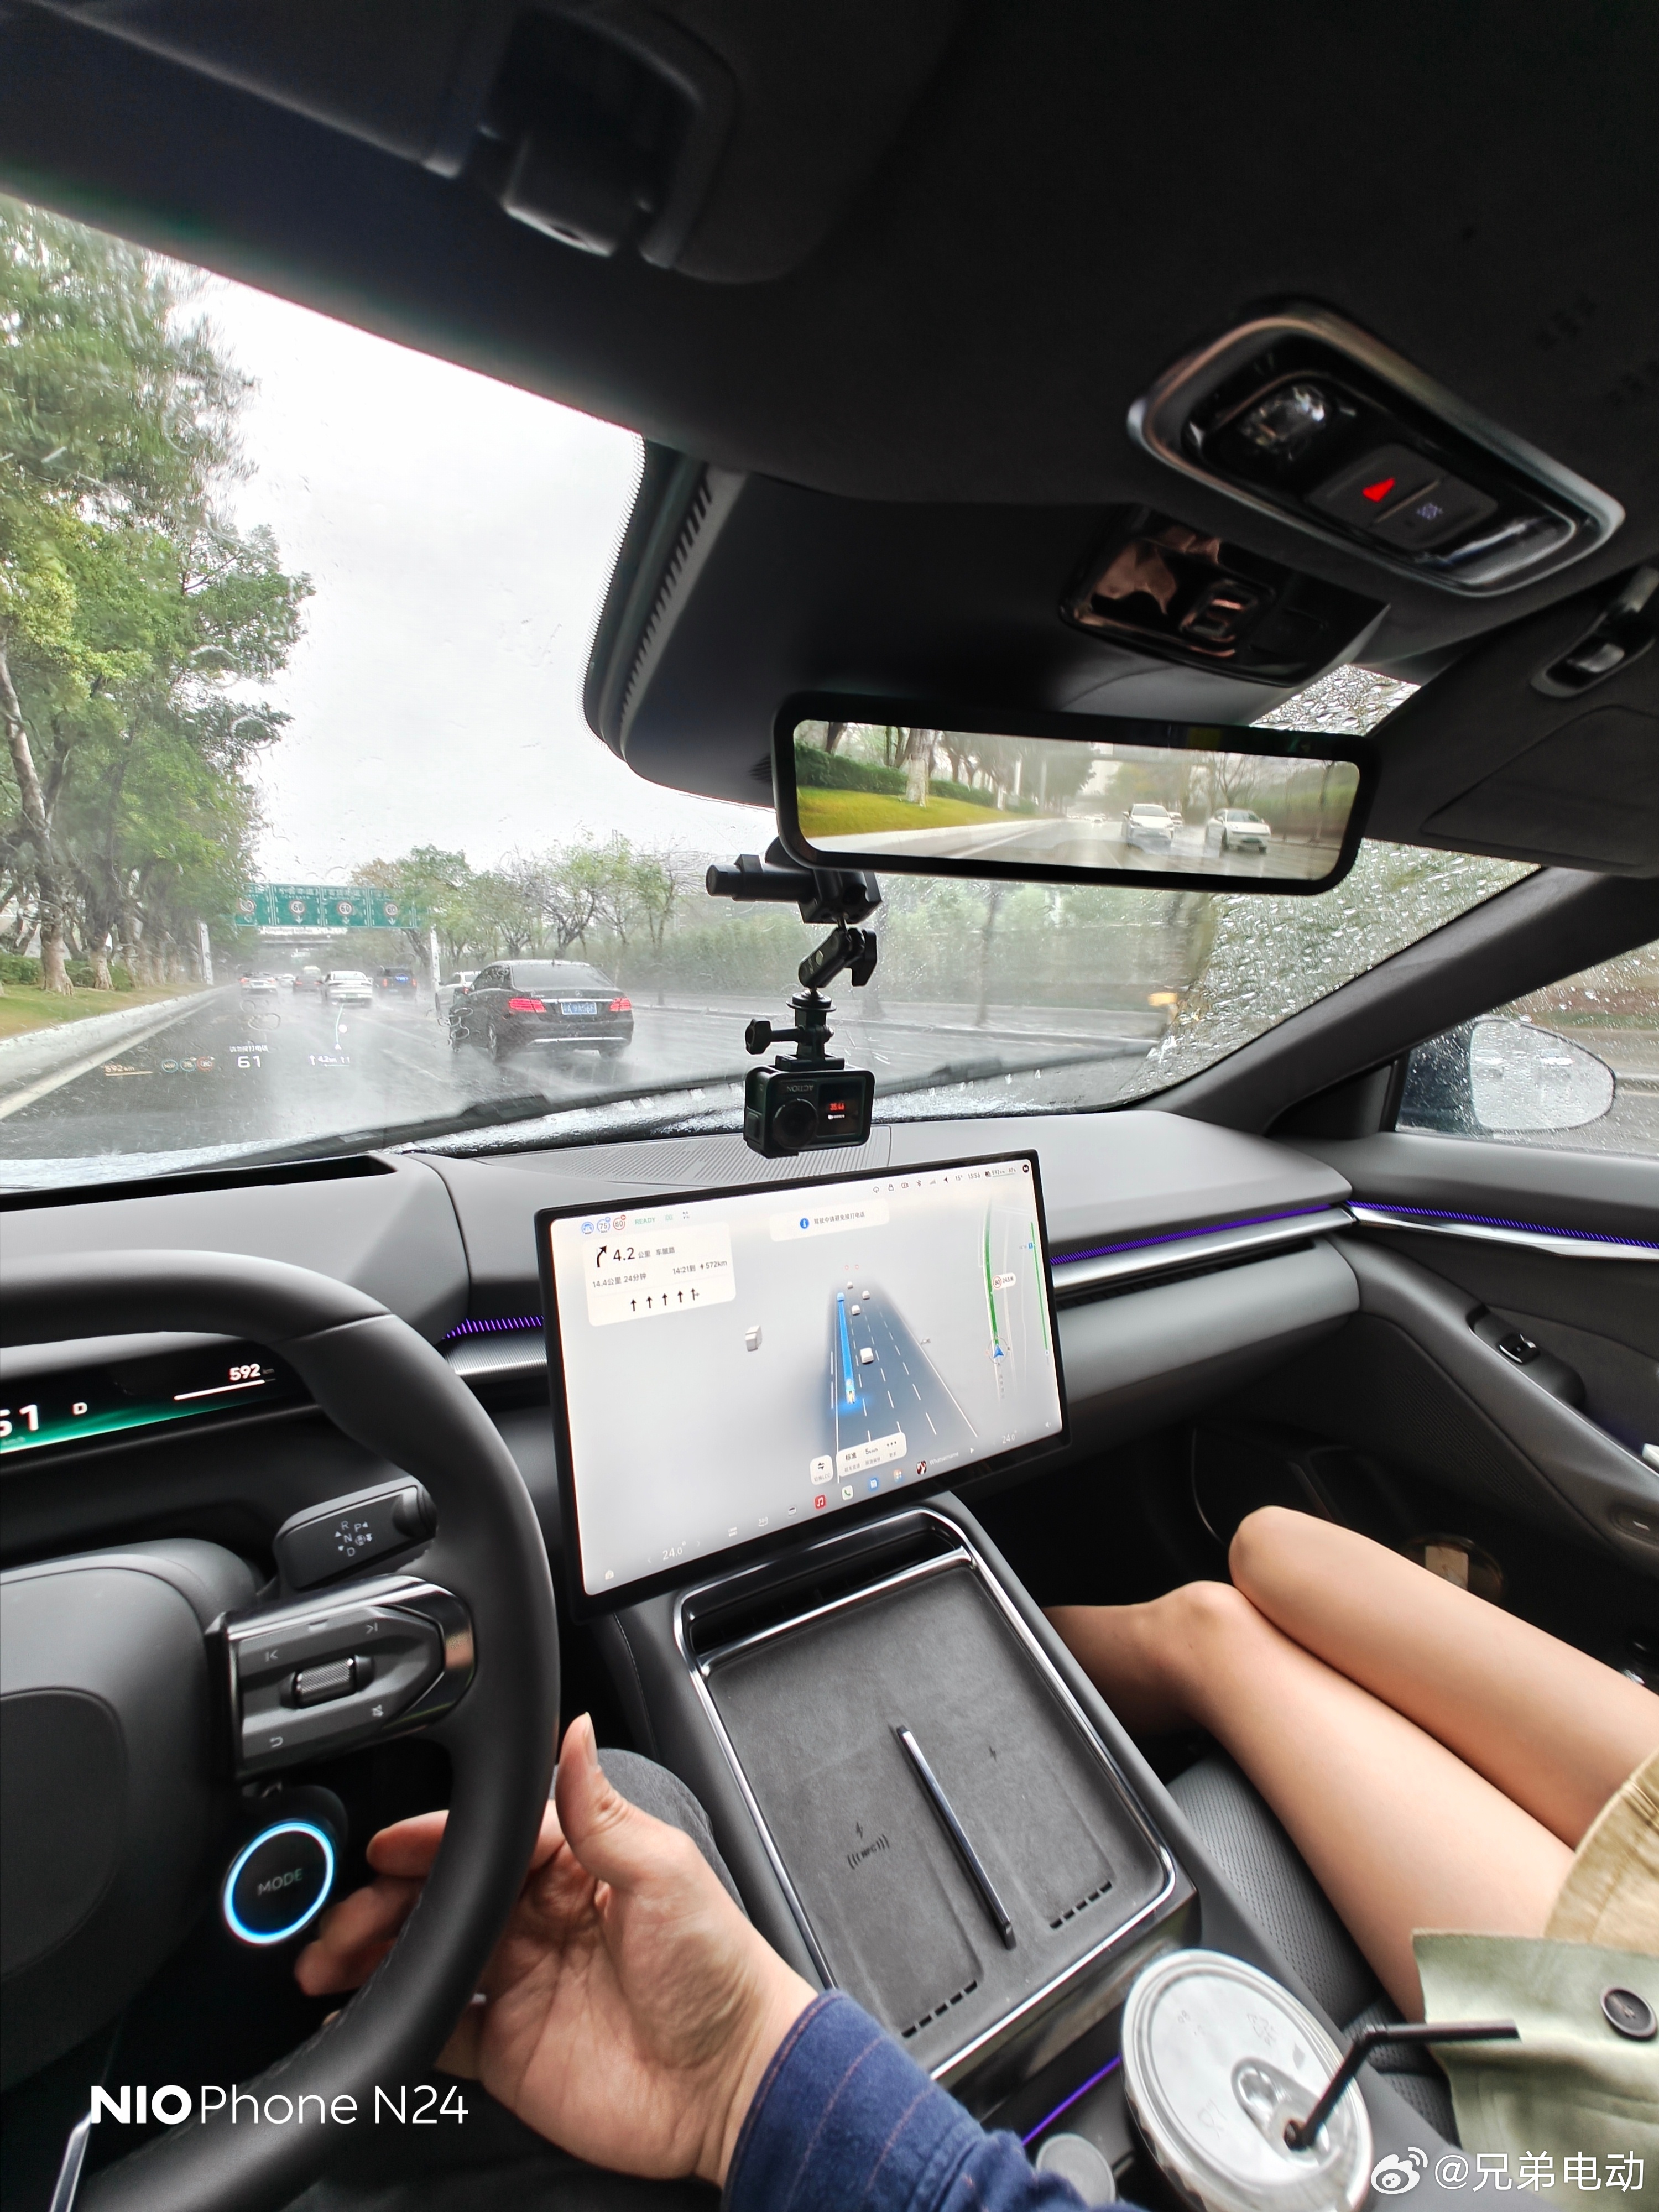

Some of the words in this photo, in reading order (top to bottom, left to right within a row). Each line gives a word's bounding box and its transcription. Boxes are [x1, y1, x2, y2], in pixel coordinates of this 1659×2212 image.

[293, 903, 302, 911] 60
[237, 1056, 261, 1068] 61
[613, 1247, 635, 1261] 4.2
[638, 1250, 651, 1259] 公里
[706, 1261, 728, 1269] 572km
[593, 1277, 622, 1288] 14.4公里
[624, 1272, 646, 1283] 24分钟
[229, 1363, 261, 1381] 592
[72, 1402, 87, 1415] D
[341, 1520, 349, 1530] R
[354, 1523, 361, 1532] P
[343, 1533, 353, 1543] N
[347, 1547, 356, 1557] D
[258, 1868, 303, 1896] MODE
